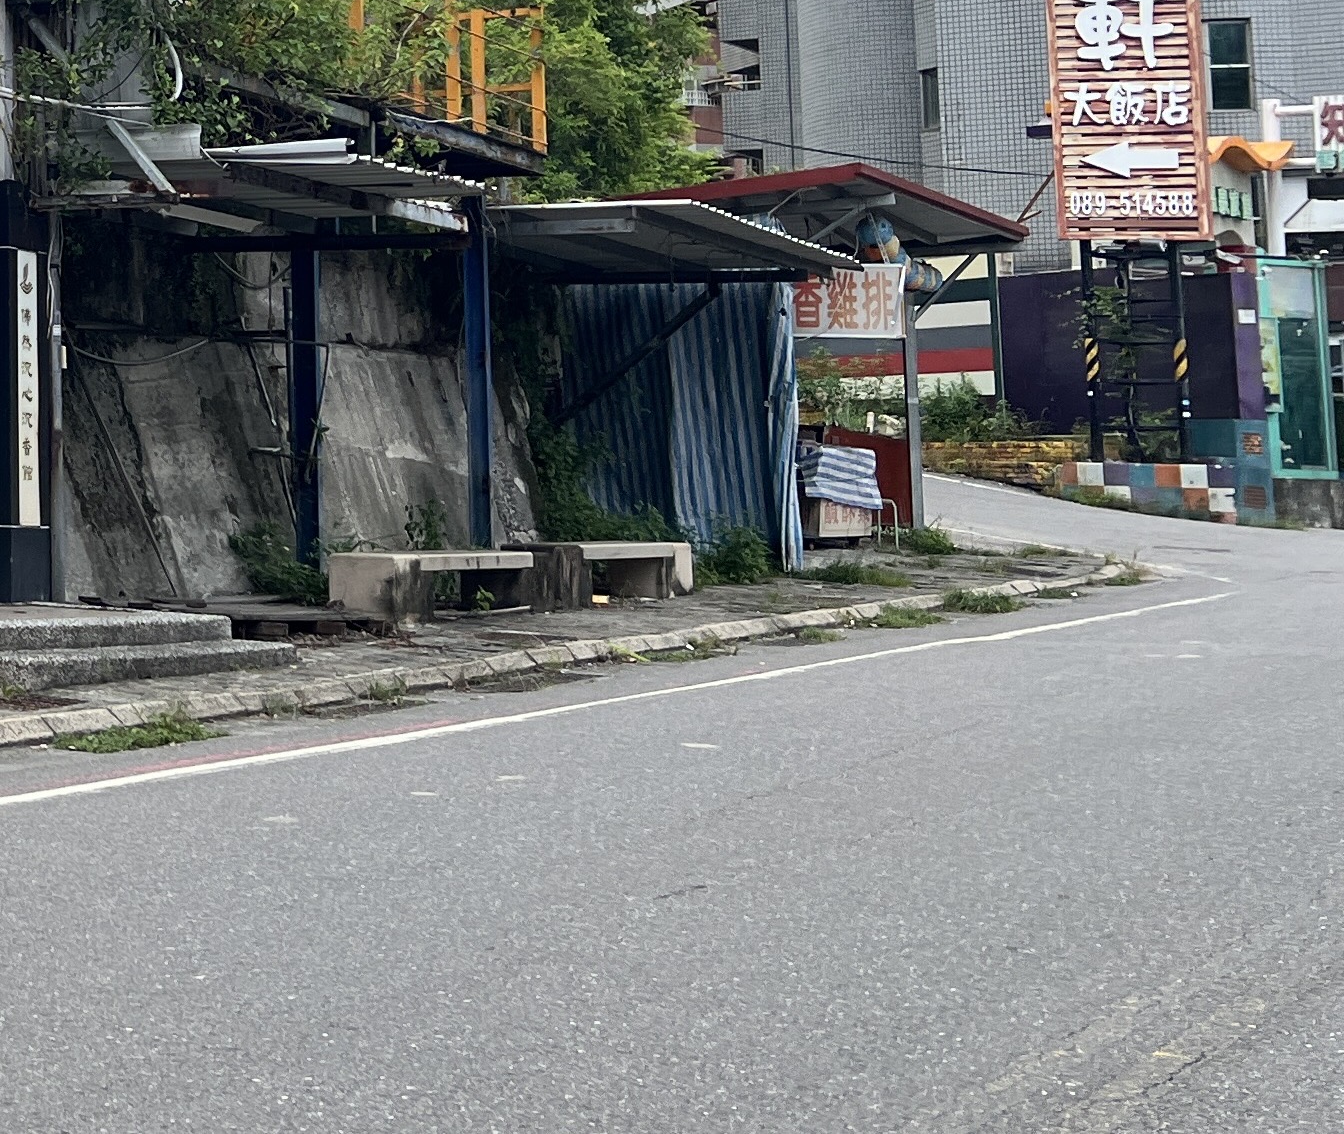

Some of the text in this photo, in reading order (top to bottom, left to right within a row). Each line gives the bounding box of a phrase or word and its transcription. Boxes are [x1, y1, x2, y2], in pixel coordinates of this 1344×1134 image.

[1064, 80, 1190, 127] 大飯店
[1070, 191, 1194, 216] 089-514588
[792, 271, 893, 330] 香雞排
